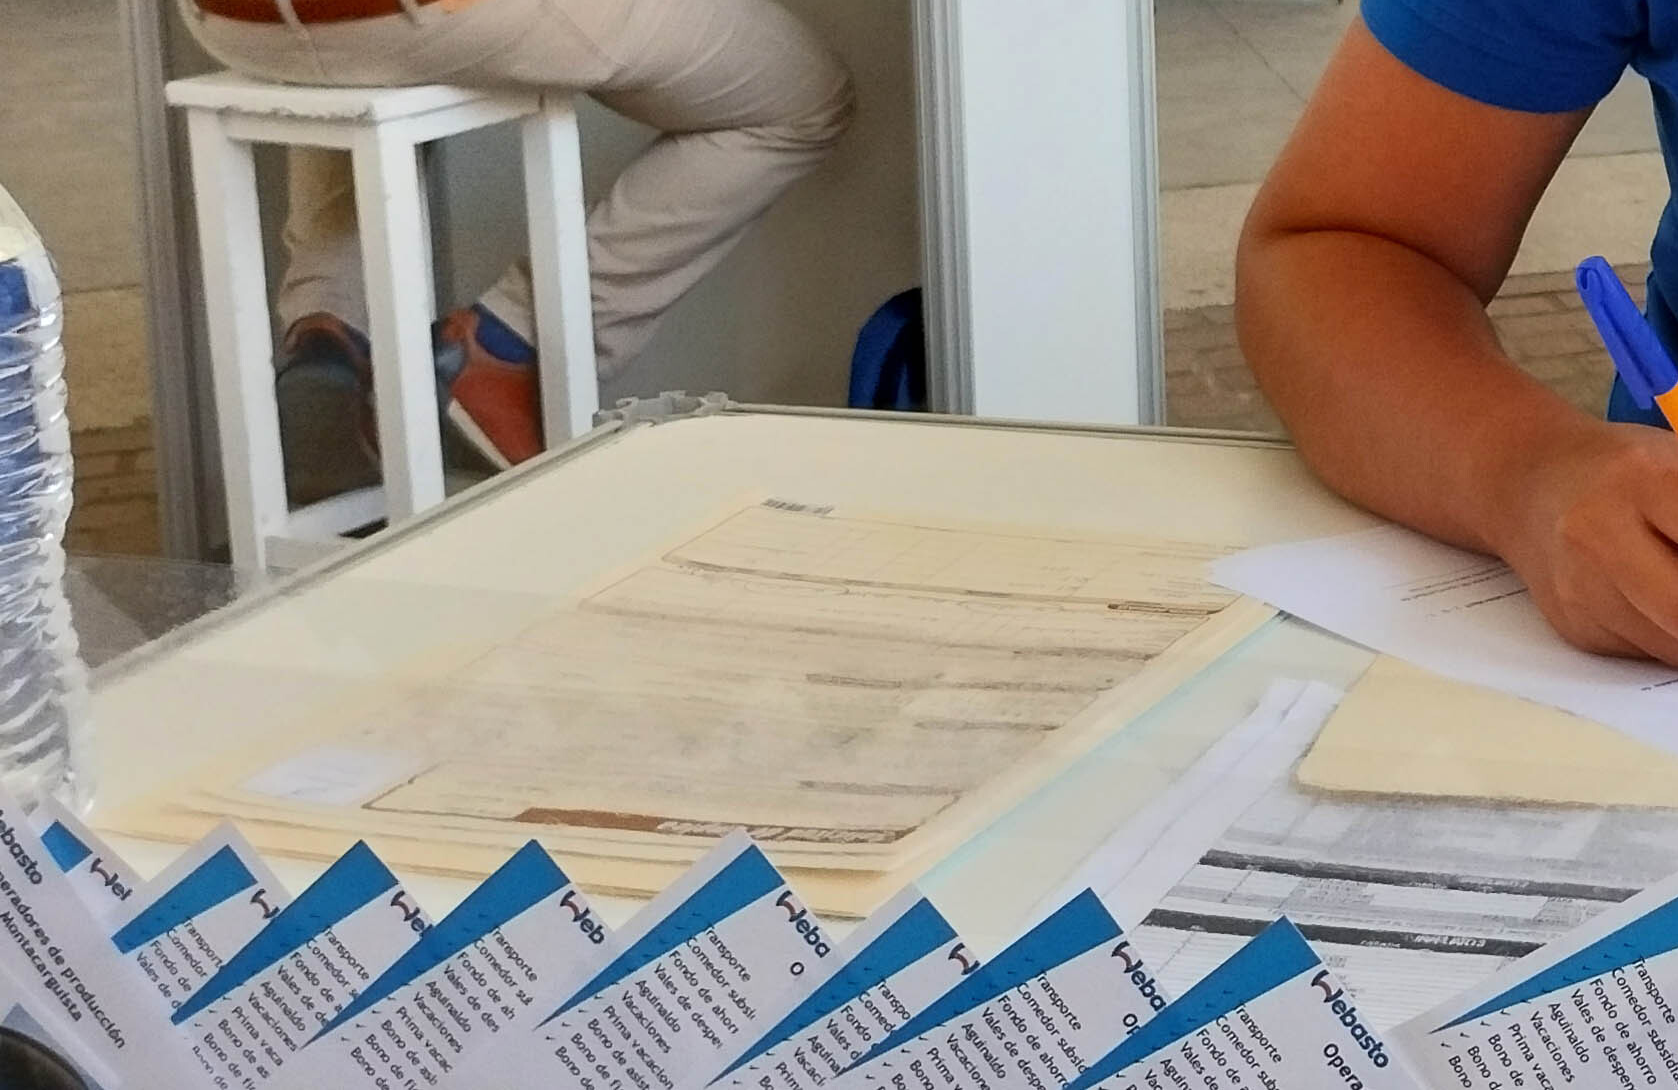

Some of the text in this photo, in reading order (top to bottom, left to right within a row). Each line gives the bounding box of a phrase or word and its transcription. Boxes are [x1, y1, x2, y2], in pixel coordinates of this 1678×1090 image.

[560, 890, 605, 945] Web
[776, 890, 831, 958] Weba
[136, 952, 175, 1000] Vales de
[150, 940, 192, 993] Fondo de
[165, 928, 209, 979] Comedor
[289, 952, 335, 1004] Fondo de
[306, 937, 352, 991] Comedor
[325, 925, 370, 982] Transporte
[457, 952, 501, 1005] Fondo de
[473, 938, 519, 993] Comedor
[493, 925, 538, 983] Transporte
[668, 950, 713, 1005] Fondo de
[686, 937, 731, 991] Comedor
[705, 925, 752, 983] Transporte
[1111, 940, 1167, 1013] Weba
[48, 946, 126, 1050] de producción
[260, 980, 307, 1032] Aguinaldo
[276, 965, 315, 1014] Vales de
[425, 980, 472, 1033] Aguinaldo
[443, 964, 469, 996] Vales
[466, 994, 482, 1012] de
[635, 980, 682, 1034] Aguinaldo
[653, 962, 692, 1012] Vales de
[876, 978, 911, 1020] Transpo
[1016, 982, 1060, 1037] Comedor
[1036, 970, 1082, 1031] Transporte
[1611, 966, 1651, 1027] Comedor
[1633, 957, 1675, 1025] Transporte
[218, 1018, 257, 1065] Bono de
[232, 1006, 259, 1040] Prima
[248, 992, 298, 1053] Vacaciones
[396, 1005, 424, 1041] Prima
[413, 992, 463, 1054] Vacaciones
[603, 1005, 631, 1041] Prima
[622, 991, 672, 1055] Vacaciones
[826, 1018, 851, 1052] Vales
[841, 1005, 872, 1043] Fondo
[981, 1007, 1019, 1058] Vales de
[998, 994, 1041, 1052] Fondo de
[1236, 1001, 1283, 1064] Transporte
[1311, 969, 1389, 1069] Webasto
[1548, 1001, 1591, 1065] Aguinaldo
[1571, 987, 1607, 1044] Vales de
[1589, 977, 1657, 1086] Fondo de ahorro
[203, 1033, 243, 1079] Bono de
[350, 1047, 376, 1078] Bono
[365, 1033, 405, 1080] Bono de
[381, 1019, 420, 1066] Bono de
[555, 1045, 580, 1077] Bono
[571, 1033, 610, 1080] Bono de
[588, 1018, 627, 1067] Bono de
[926, 1046, 954, 1084] Prima
[961, 1022, 1007, 1079] Aguinaldo
[1180, 1040, 1206, 1074] Vales
[1195, 1028, 1242, 1085] Fondo de
[1214, 1014, 1260, 1071] Comedor
[1323, 1042, 1364, 1090] Opera
[1467, 1045, 1491, 1081] Bono
[1487, 1033, 1525, 1088] Bono de
[1507, 1023, 1533, 1065] Prima
[1529, 1010, 1576, 1085] Vacaciones
[1448, 1055, 1473, 1090] Bono
